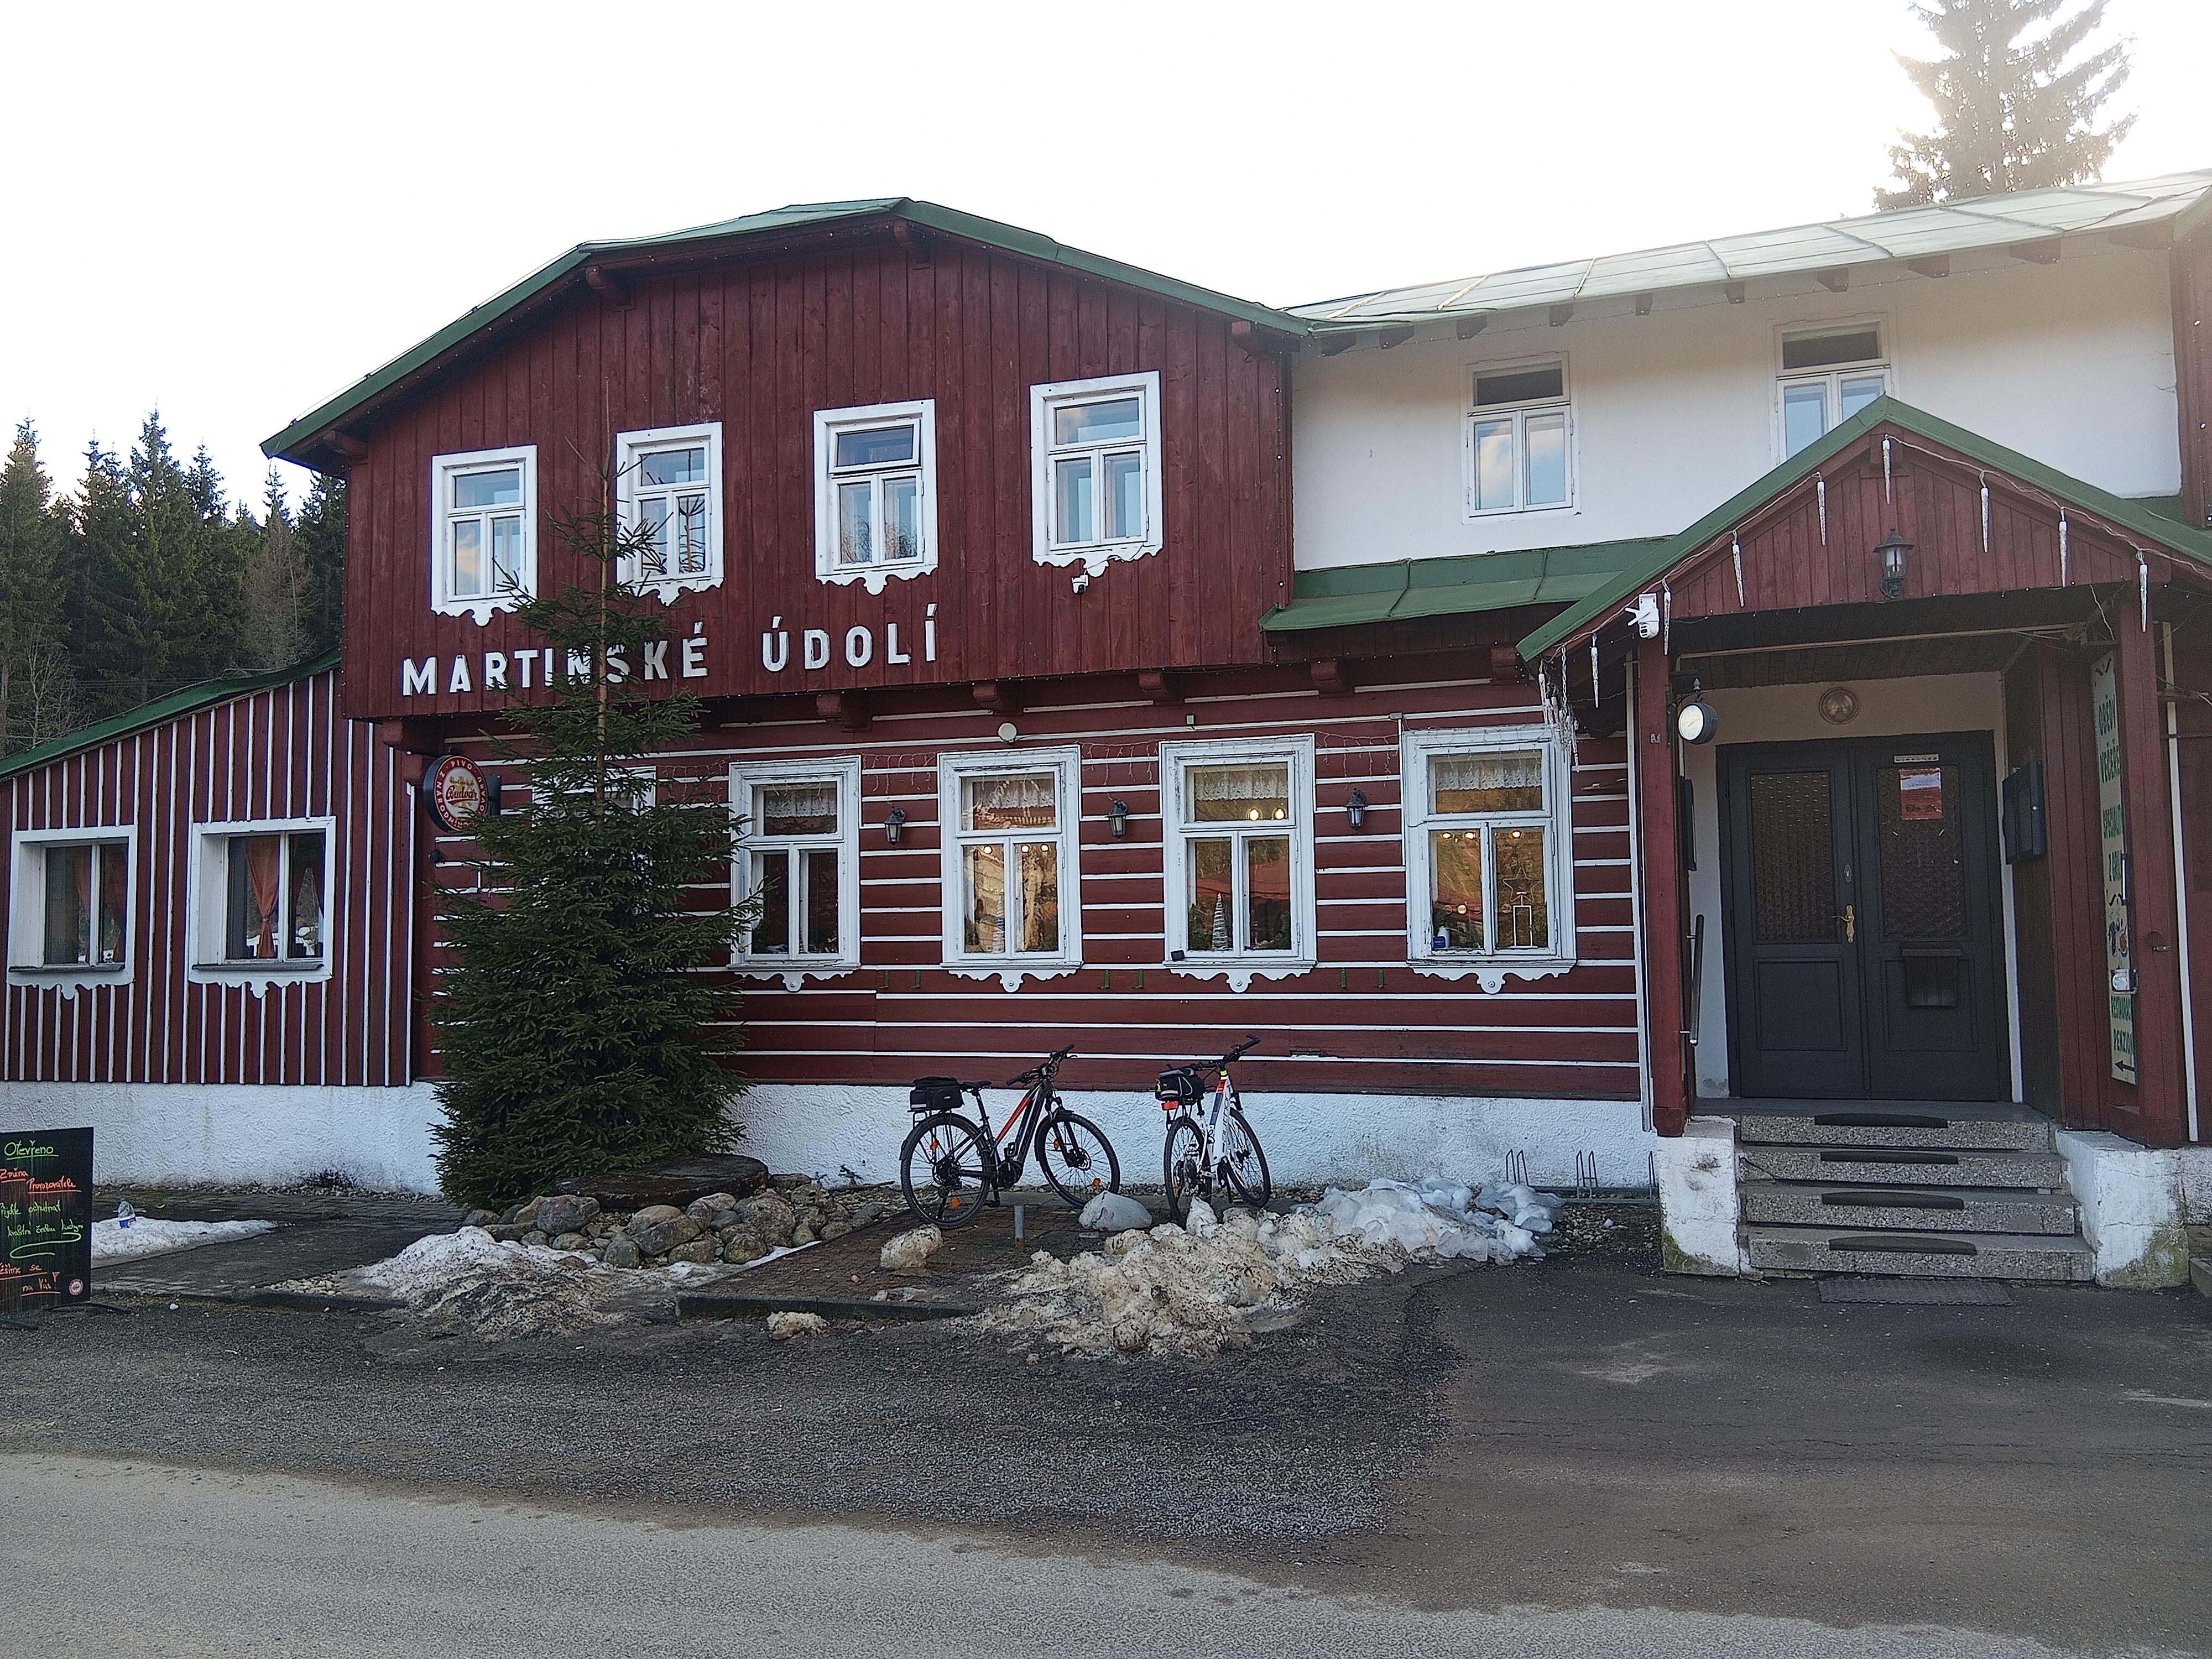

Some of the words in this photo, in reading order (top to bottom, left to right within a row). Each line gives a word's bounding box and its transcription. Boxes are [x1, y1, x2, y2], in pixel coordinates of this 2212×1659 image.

[403, 621, 708, 696] MARTINSKÉ
[763, 603, 937, 672] ÚDOLÍ
[451, 759, 472, 770] PIVO
[4, 1140, 54, 1156] Otevřeno
